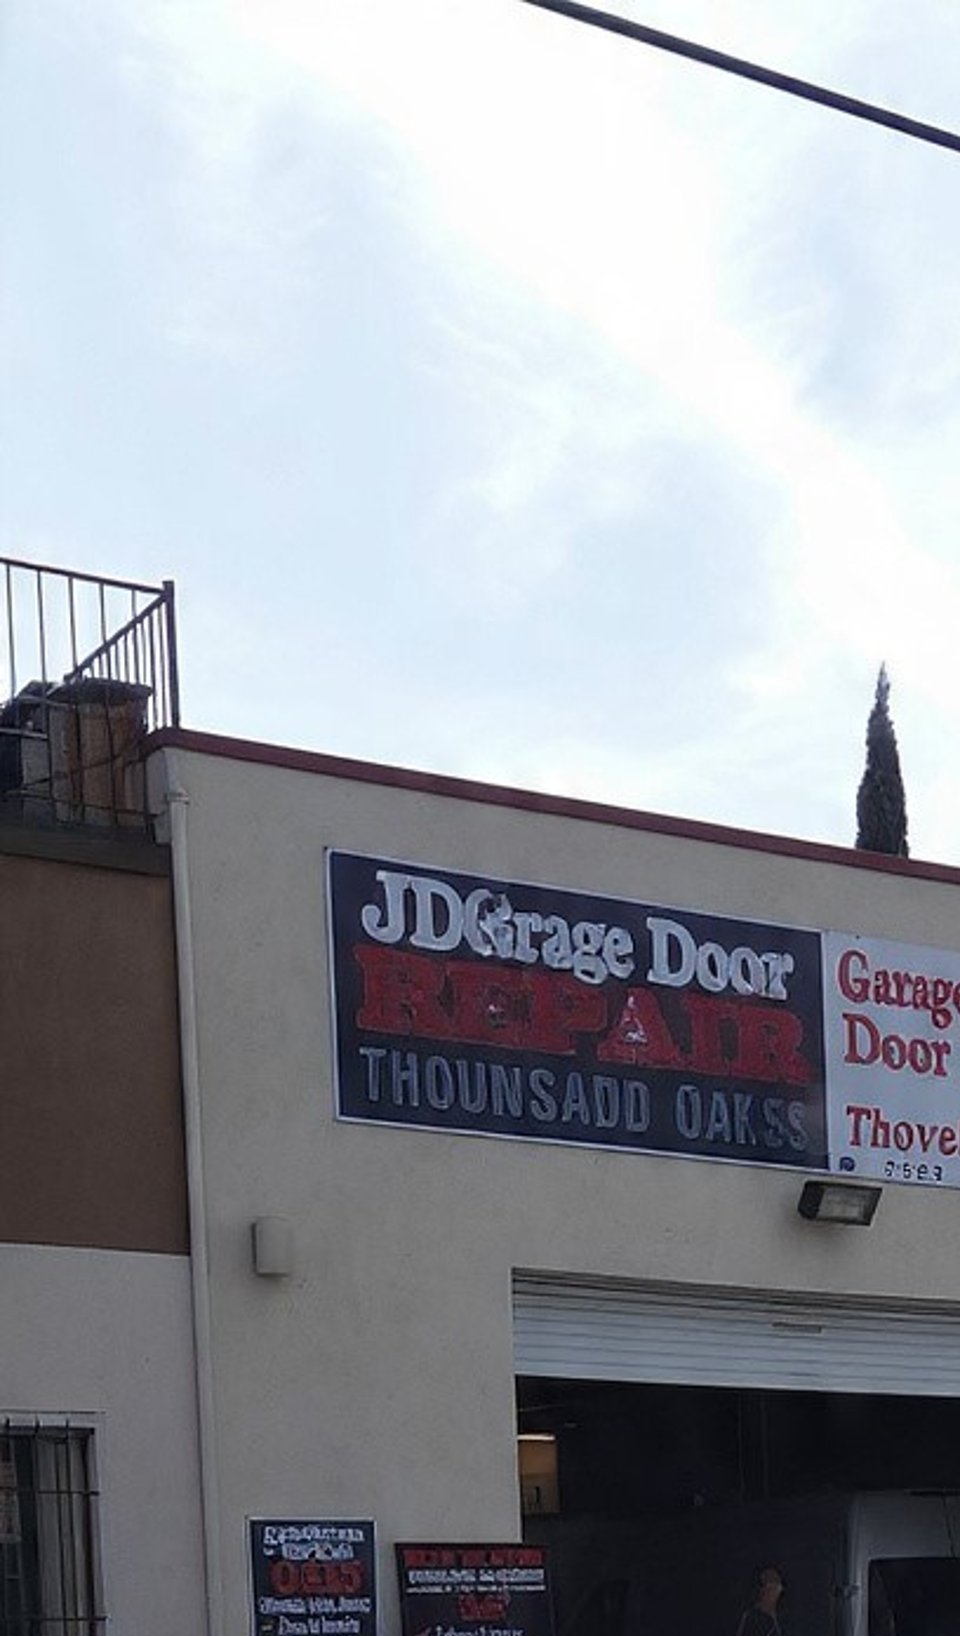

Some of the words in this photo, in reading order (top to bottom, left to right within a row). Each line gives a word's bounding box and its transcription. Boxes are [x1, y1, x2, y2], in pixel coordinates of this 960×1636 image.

[646, 915, 795, 1001] Door
[354, 943, 812, 1086] REPAIR
[842, 1013, 951, 1077] Door
